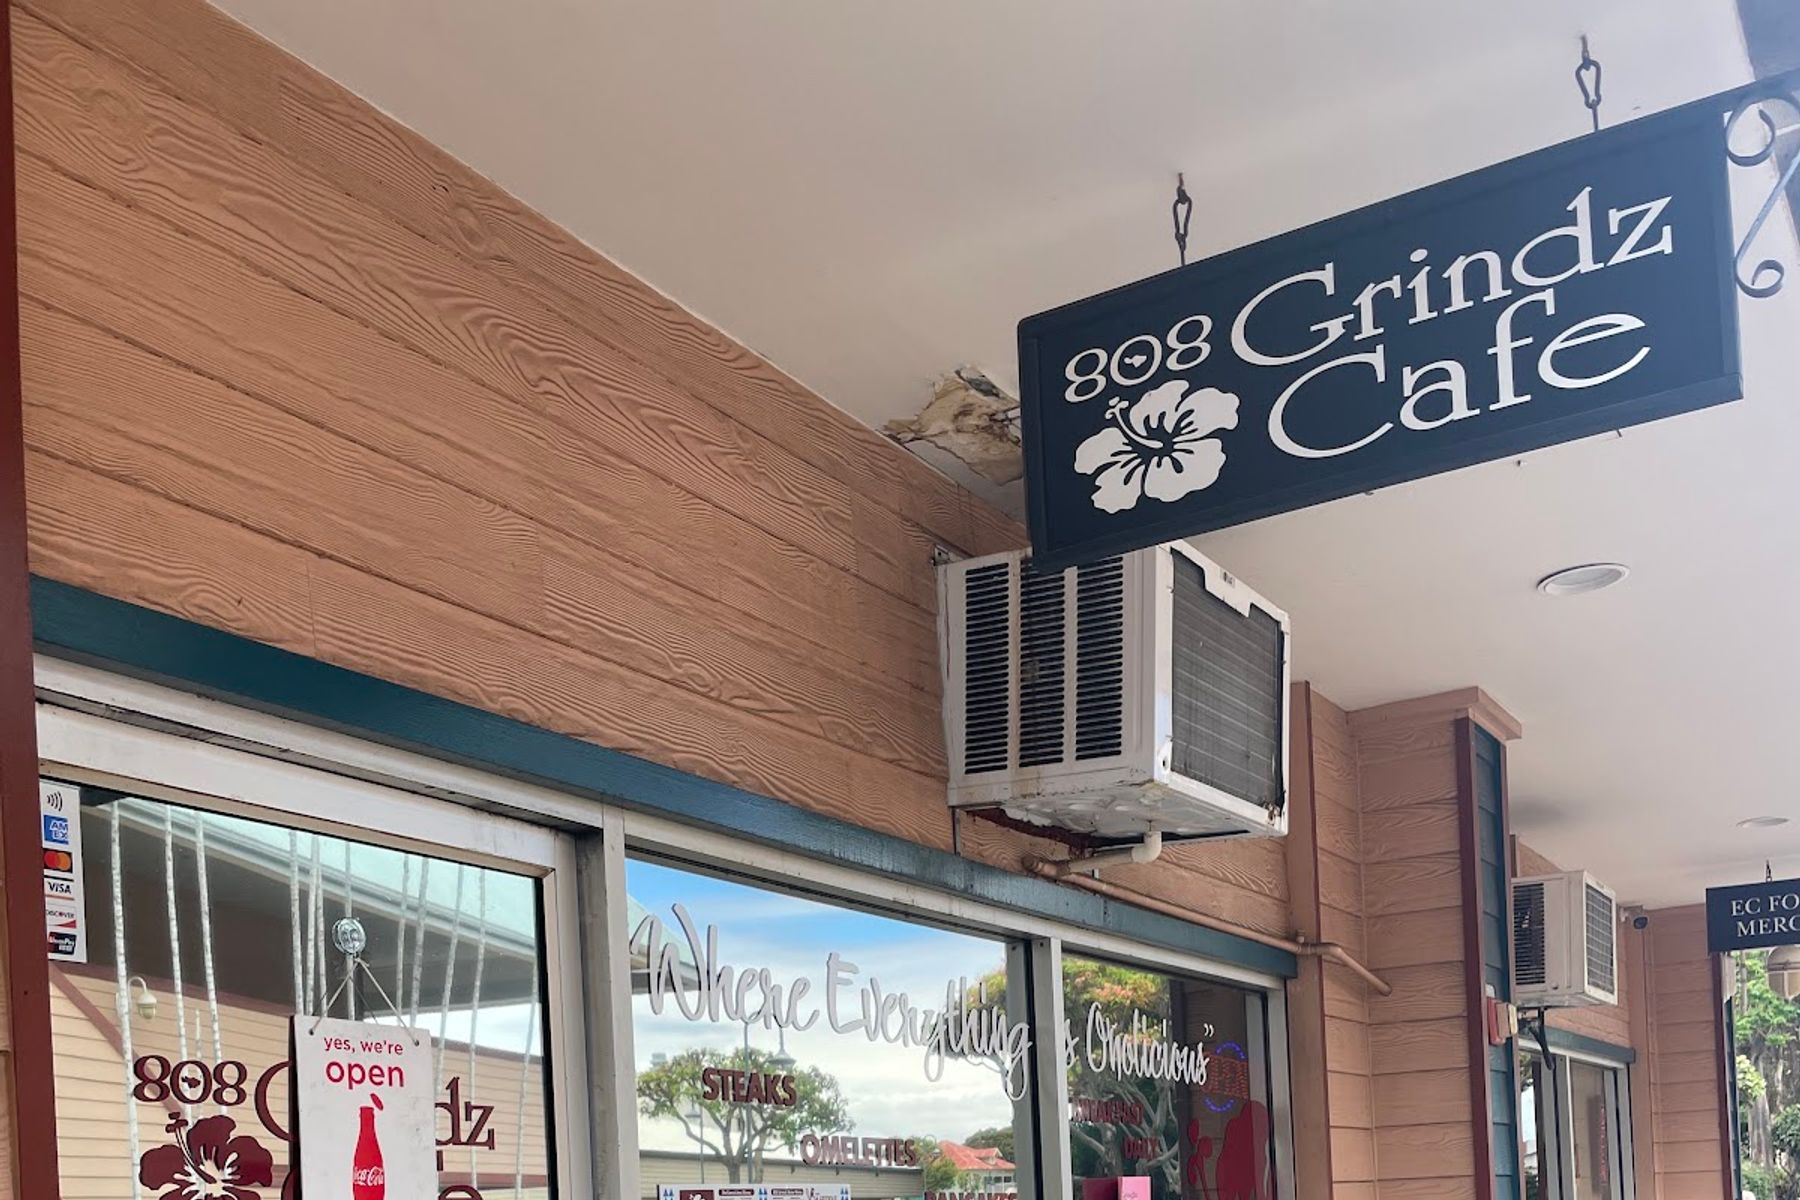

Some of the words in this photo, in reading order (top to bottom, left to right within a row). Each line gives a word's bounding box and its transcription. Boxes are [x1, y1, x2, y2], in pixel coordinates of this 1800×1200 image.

[1064, 314, 1213, 403] 808
[1229, 185, 1673, 367] Grindz
[1266, 288, 1652, 459] Cafe
[47, 881, 72, 894] VISA
[1731, 897, 1761, 917] EC
[1768, 893, 1800, 912] FO
[1737, 914, 1800, 937] MERC
[629, 902, 820, 1032] Where
[826, 951, 1032, 1101] Everything
[1063, 1016, 1080, 1069] s
[324, 1035, 356, 1054] yes,
[360, 1039, 404, 1056] we're
[133, 1055, 248, 1106] 808
[325, 1060, 405, 1090] open
[702, 1066, 798, 1107] STEAKS
[799, 1134, 919, 1167] OMELETTES
